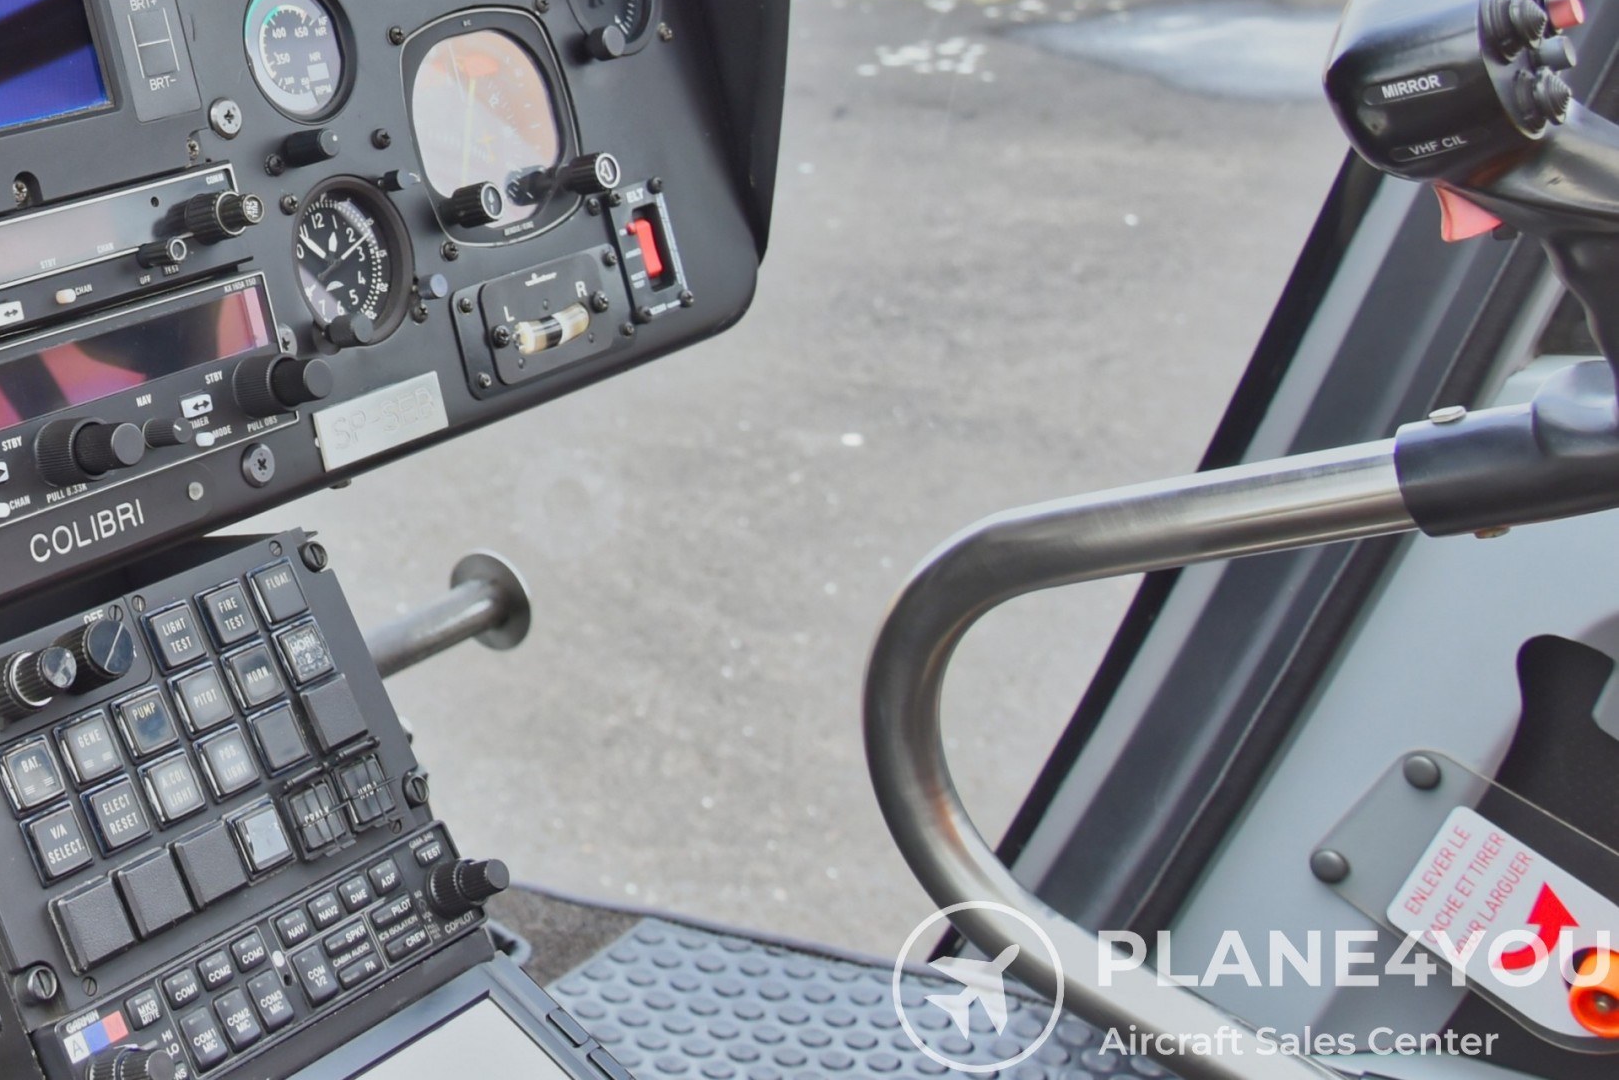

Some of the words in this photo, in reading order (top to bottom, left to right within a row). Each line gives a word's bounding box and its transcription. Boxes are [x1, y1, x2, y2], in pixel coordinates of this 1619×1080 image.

[149, 75, 177, 91] BRT-
[1381, 74, 1441, 100] MIRROR
[1408, 139, 1438, 157] VHF
[626, 187, 644, 203] ELT
[311, 212, 325, 229] 12
[346, 227, 356, 243] 2
[356, 246, 365, 262] 3
[140, 275, 151, 285] OFF
[357, 270, 366, 285] 4
[75, 284, 93, 296] CHAN
[348, 289, 359, 305] 5
[575, 281, 588, 298] R
[503, 305, 515, 322] L
[205, 370, 223, 385] STBY
[136, 393, 152, 408] NAV
[212, 424, 232, 439] MODE
[247, 421, 264, 433] PULL
[1, 436, 23, 452] STBY
[9, 495, 31, 511] CHAN
[46, 488, 66, 504] PULL
[30, 498, 145, 563] COLIBRI
[218, 597, 238, 614] FIRE
[162, 617, 187, 637] LIGHT
[224, 614, 245, 632] TEST
[170, 636, 193, 654] TEST
[193, 688, 218, 708] PITOT
[132, 702, 156, 721] PUMP
[21, 755, 42, 773] BAT.
[223, 761, 248, 781] LIGHT
[102, 793, 131, 816] ELECT
[169, 787, 193, 808] LIGHT
[50, 823, 68, 840] V/A
[109, 812, 139, 836] RESET
[47, 840, 85, 865] SELECT.
[421, 845, 441, 862] TEST
[1404, 846, 1457, 916] ENLEVER
[1453, 824, 1471, 849] LE
[381, 872, 396, 889] ADF
[1422, 892, 1462, 945] CACHE
[1454, 874, 1477, 898] ET
[1469, 831, 1507, 880] TIRER
[1482, 849, 1534, 923] LARGUER
[350, 888, 368, 904] DME
[317, 905, 339, 922] NAV2
[391, 898, 412, 917] PILOT
[444, 911, 475, 934] COPILOT
[287, 923, 308, 940] NAV1
[345, 924, 367, 943] SPKR
[405, 930, 426, 948] CREW
[242, 946, 264, 965] COM3
[208, 964, 232, 983] COM2
[307, 964, 326, 981] COM
[364, 960, 376, 973] PA
[315, 975, 328, 988] 1/2
[175, 982, 198, 1002] COM1
[260, 990, 283, 1009] COM3
[137, 1000, 157, 1016] MKR
[269, 1001, 284, 1015] MIC
[65, 1009, 100, 1034] GARMIN
[227, 1007, 251, 1027] COM2
[236, 1019, 252, 1034] MIC
[161, 1029, 174, 1043] HI
[193, 1028, 217, 1047] COM1
[166, 1042, 180, 1058] LO
[202, 1039, 218, 1054] MIC
